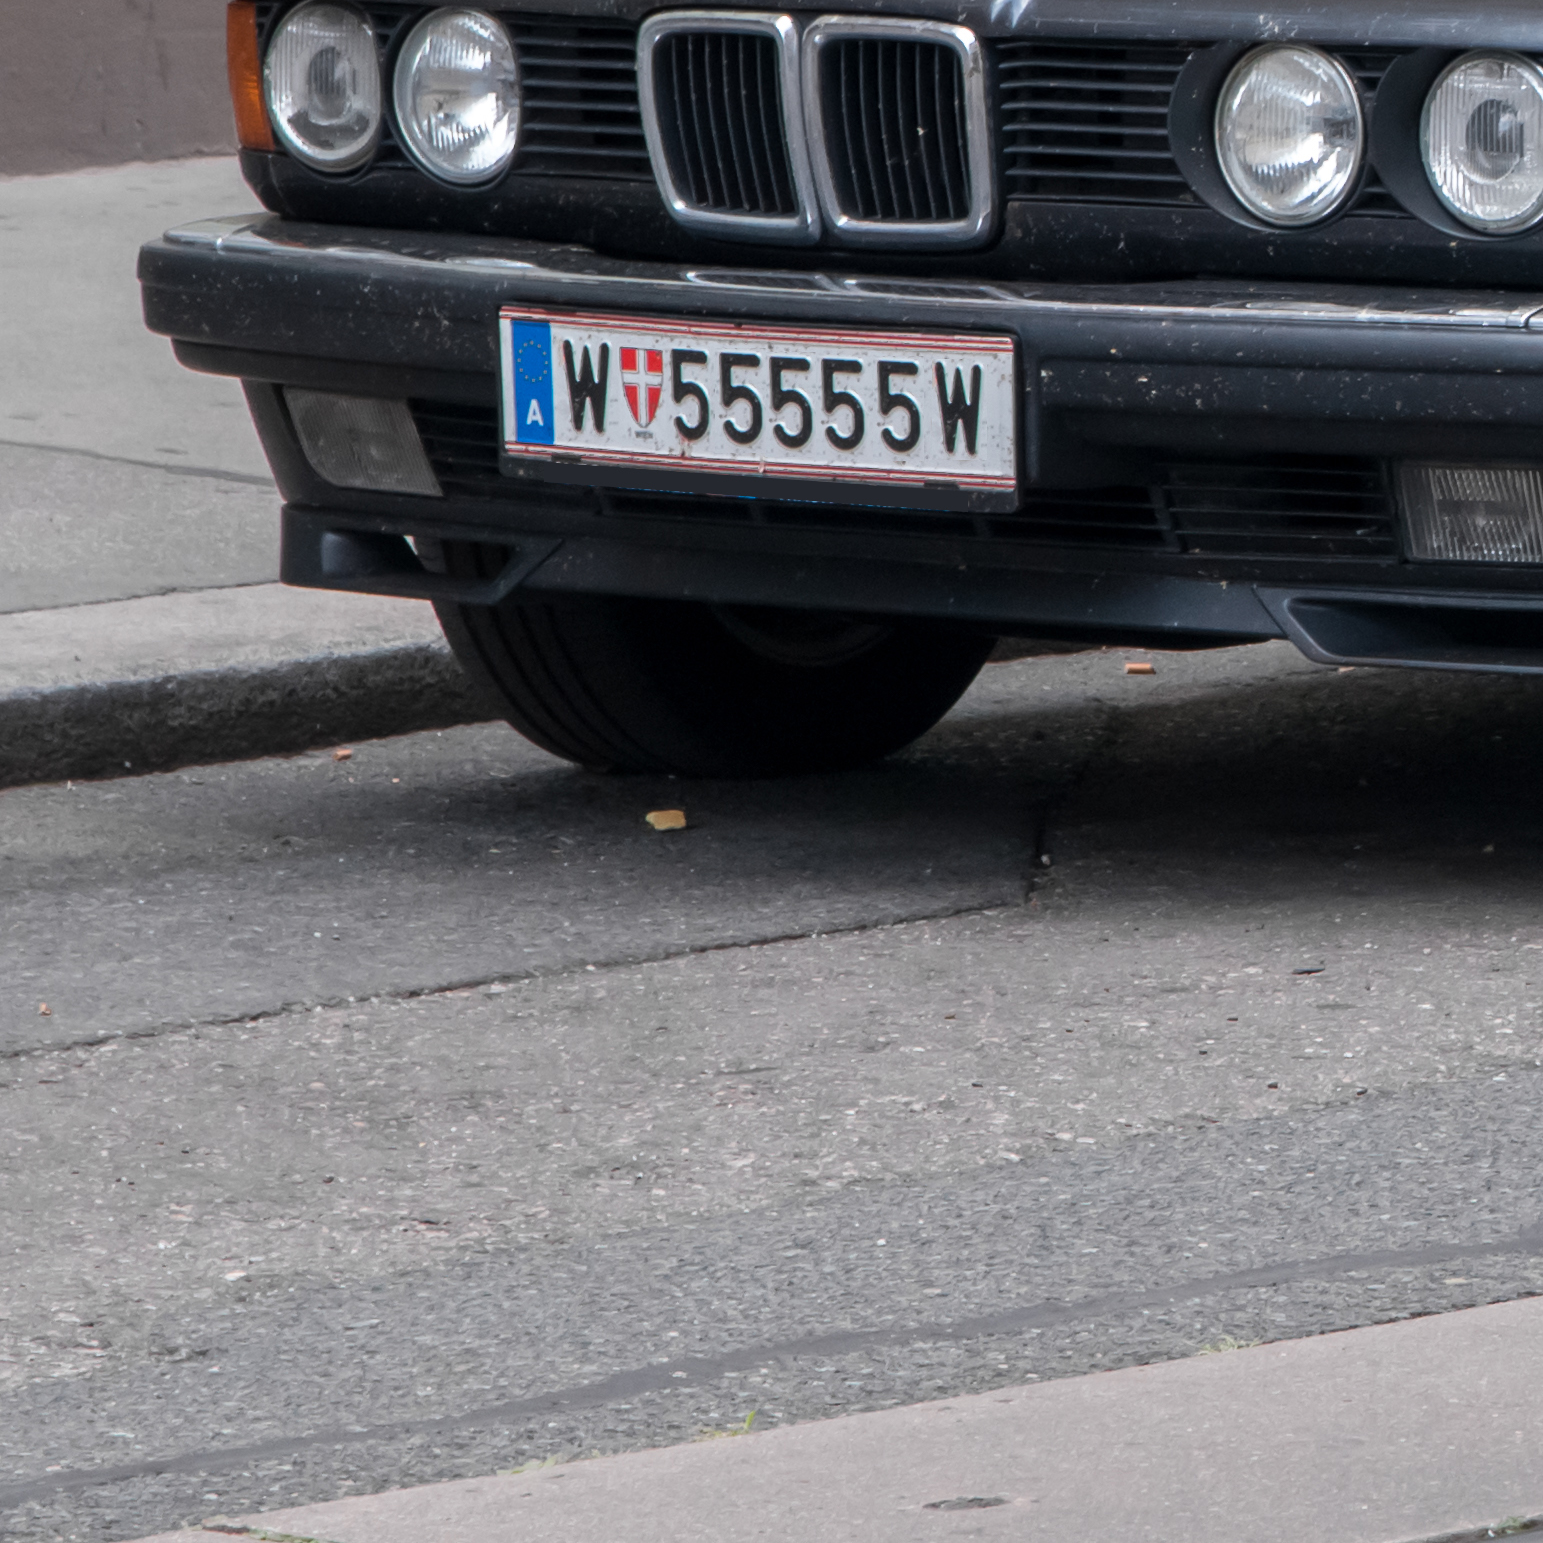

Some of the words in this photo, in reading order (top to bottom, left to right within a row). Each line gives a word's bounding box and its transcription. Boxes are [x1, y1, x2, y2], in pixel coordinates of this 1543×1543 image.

[526, 398, 545, 427] A
[562, 339, 611, 434] W
[670, 347, 983, 456] 55555W
